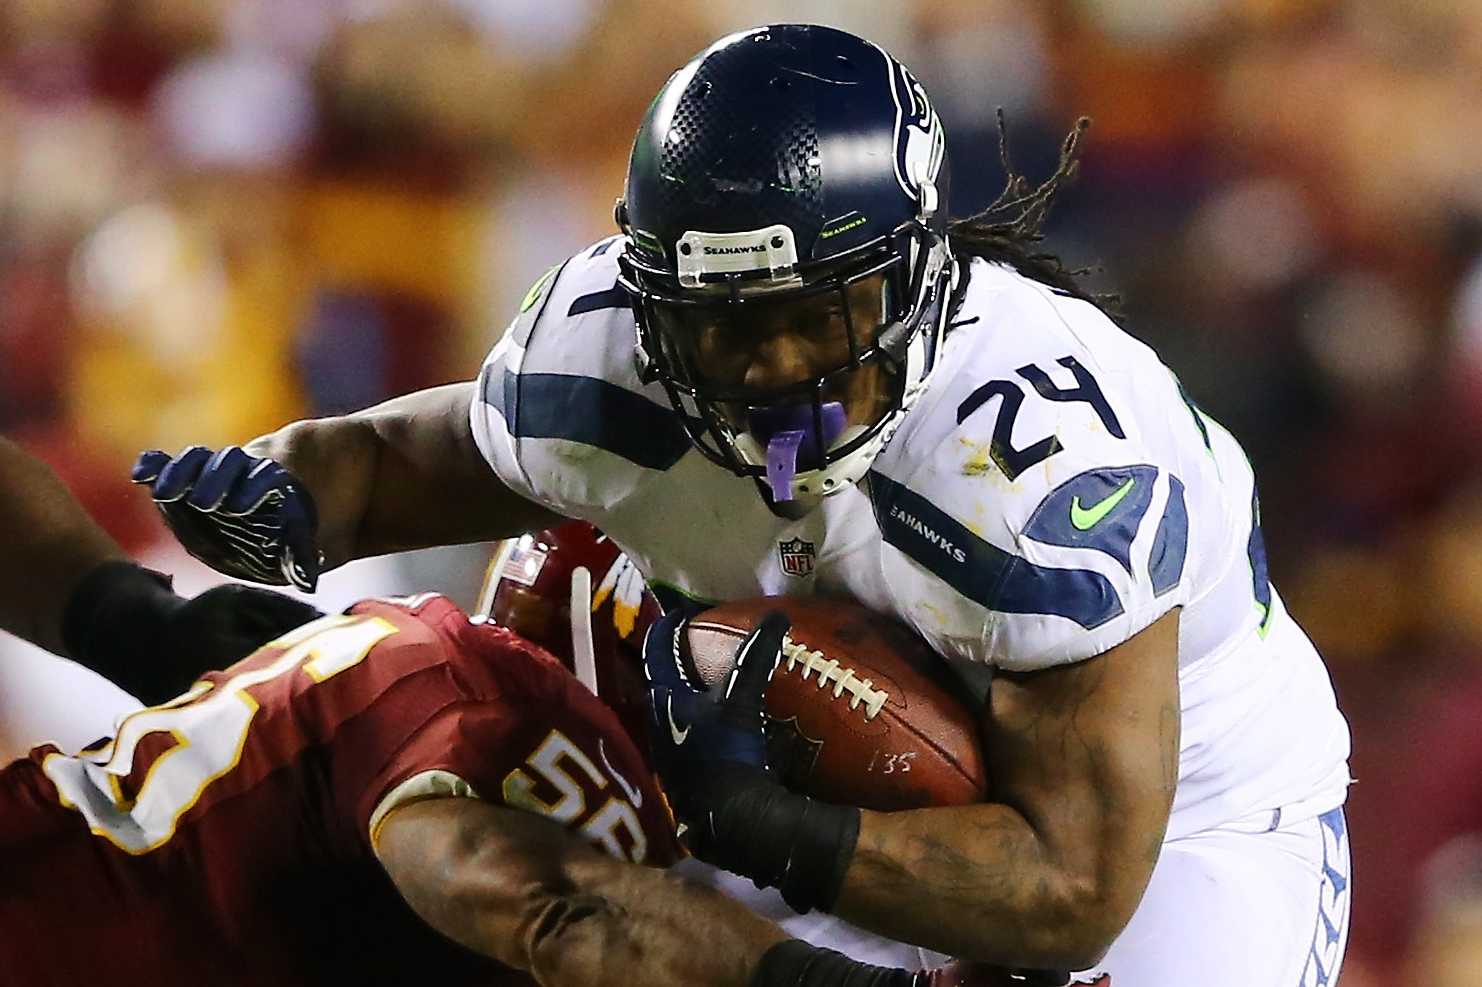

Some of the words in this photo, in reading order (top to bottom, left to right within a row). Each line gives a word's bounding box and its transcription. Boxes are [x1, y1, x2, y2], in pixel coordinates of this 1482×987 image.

[703, 245, 767, 256] SEAHAWKS
[956, 355, 1127, 483] 24
[890, 504, 967, 563] EAHAWKS
[784, 555, 815, 572] NFL
